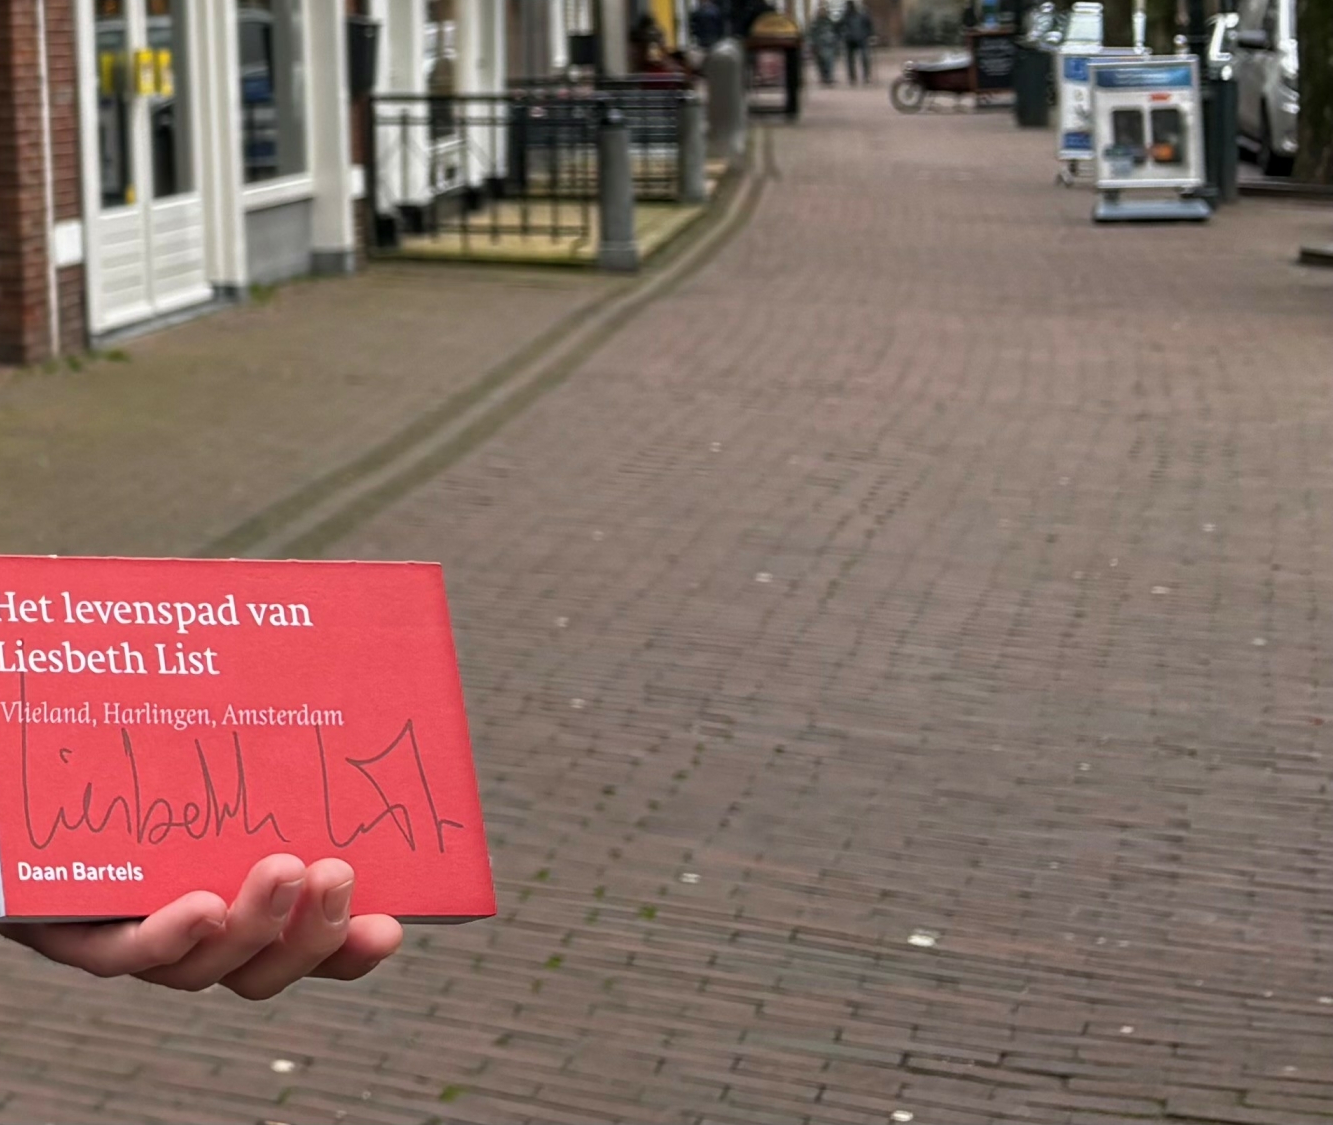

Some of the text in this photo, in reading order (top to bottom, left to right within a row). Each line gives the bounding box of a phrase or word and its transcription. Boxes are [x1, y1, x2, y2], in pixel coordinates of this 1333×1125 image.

[61, 592, 240, 634] levenspad
[246, 602, 313, 627] van
[154, 643, 220, 675] List
[0, 701, 344, 730] Vlieland, Harlingen, Amsterdam
[18, 862, 144, 881] Daan Bartels
